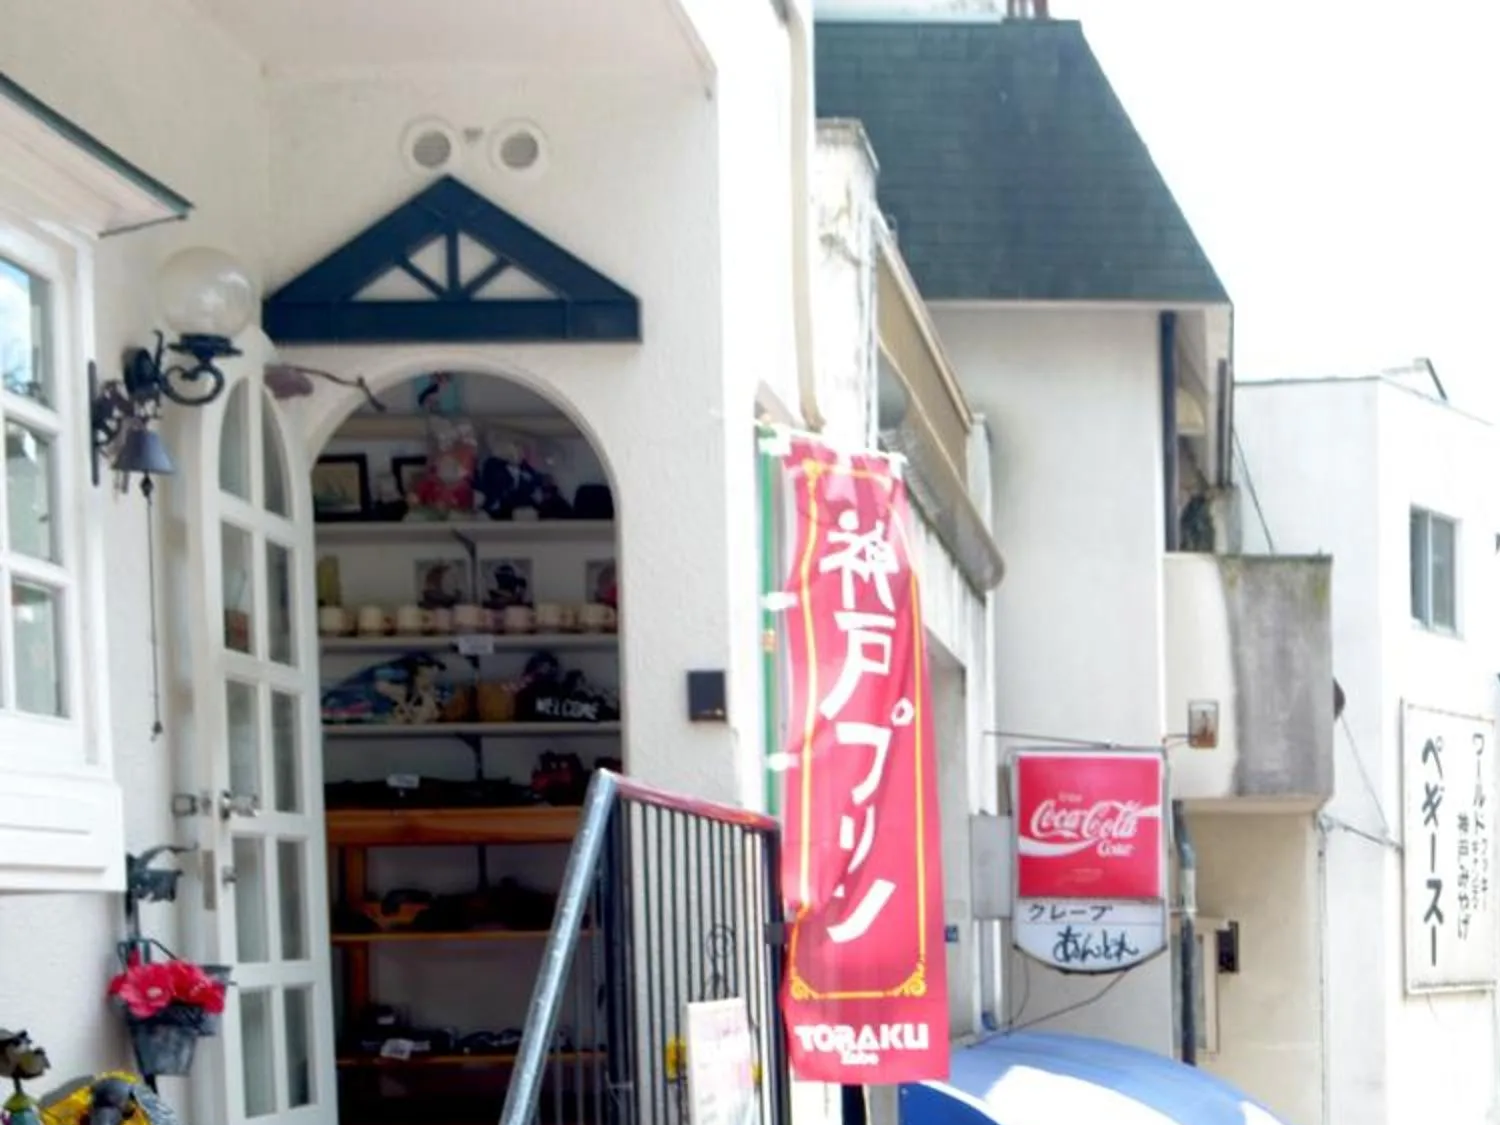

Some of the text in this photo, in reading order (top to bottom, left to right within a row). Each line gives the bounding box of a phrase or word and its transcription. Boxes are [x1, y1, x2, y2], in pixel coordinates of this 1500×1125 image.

[819, 511, 914, 943] 神戸プリン
[1028, 903, 1114, 922] クレープ
[1421, 735, 1444, 968] ペギースー
[794, 1023, 929, 1053] TORAKU
